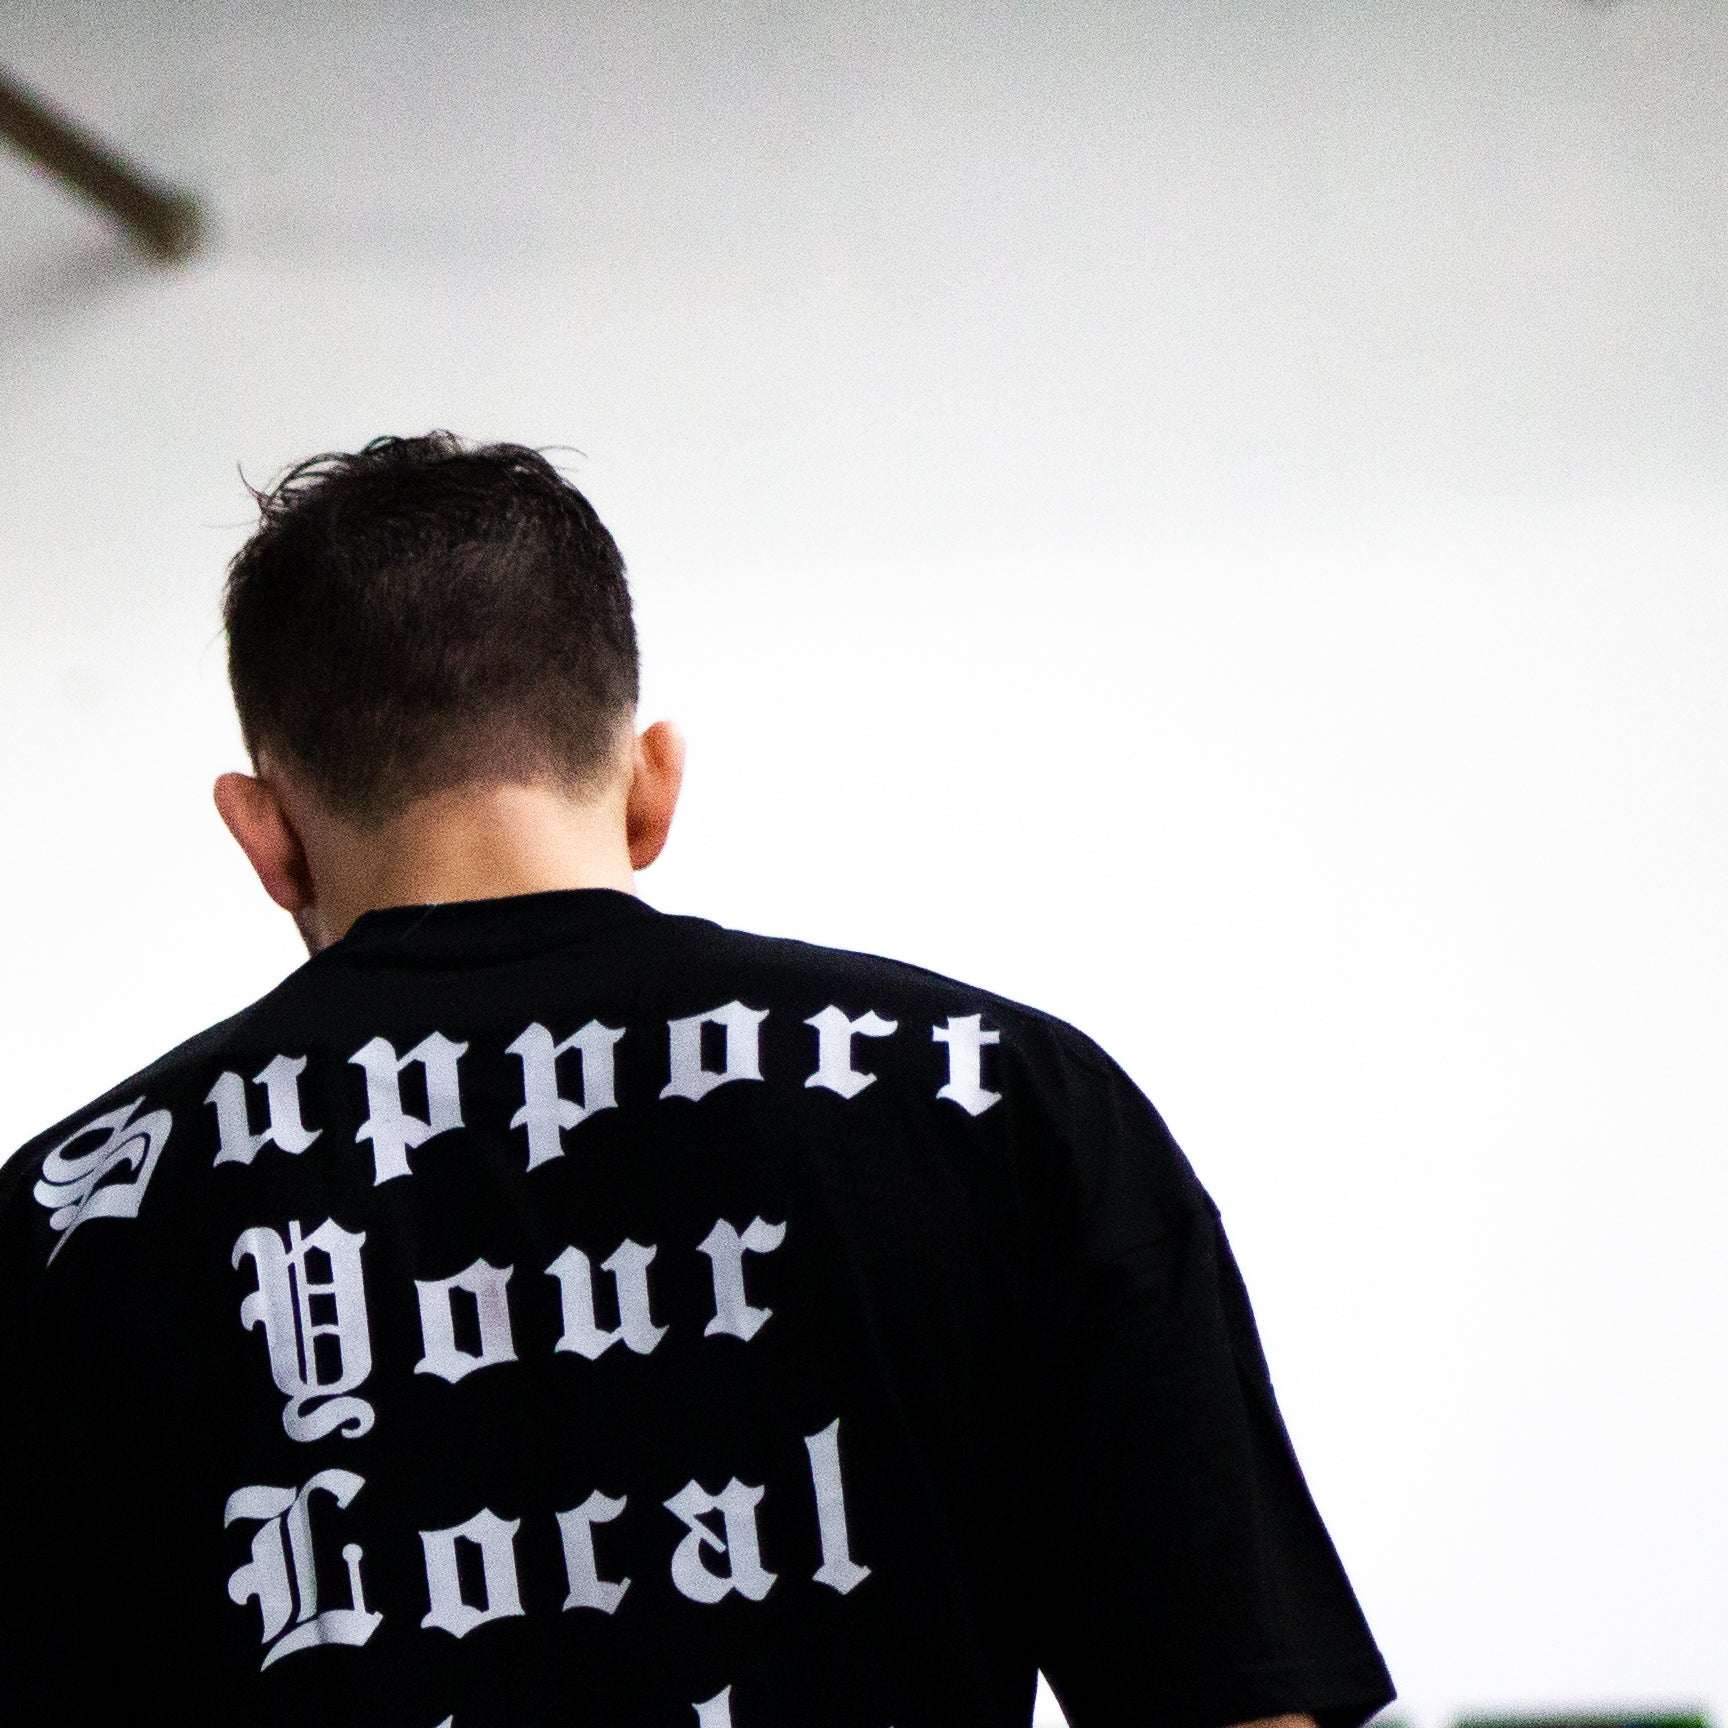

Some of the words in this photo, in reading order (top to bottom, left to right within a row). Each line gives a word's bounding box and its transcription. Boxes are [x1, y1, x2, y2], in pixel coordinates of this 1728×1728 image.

[32, 999, 1002, 1267] Support
[231, 1215, 787, 1443] Your
[224, 1418, 871, 1672] Local
